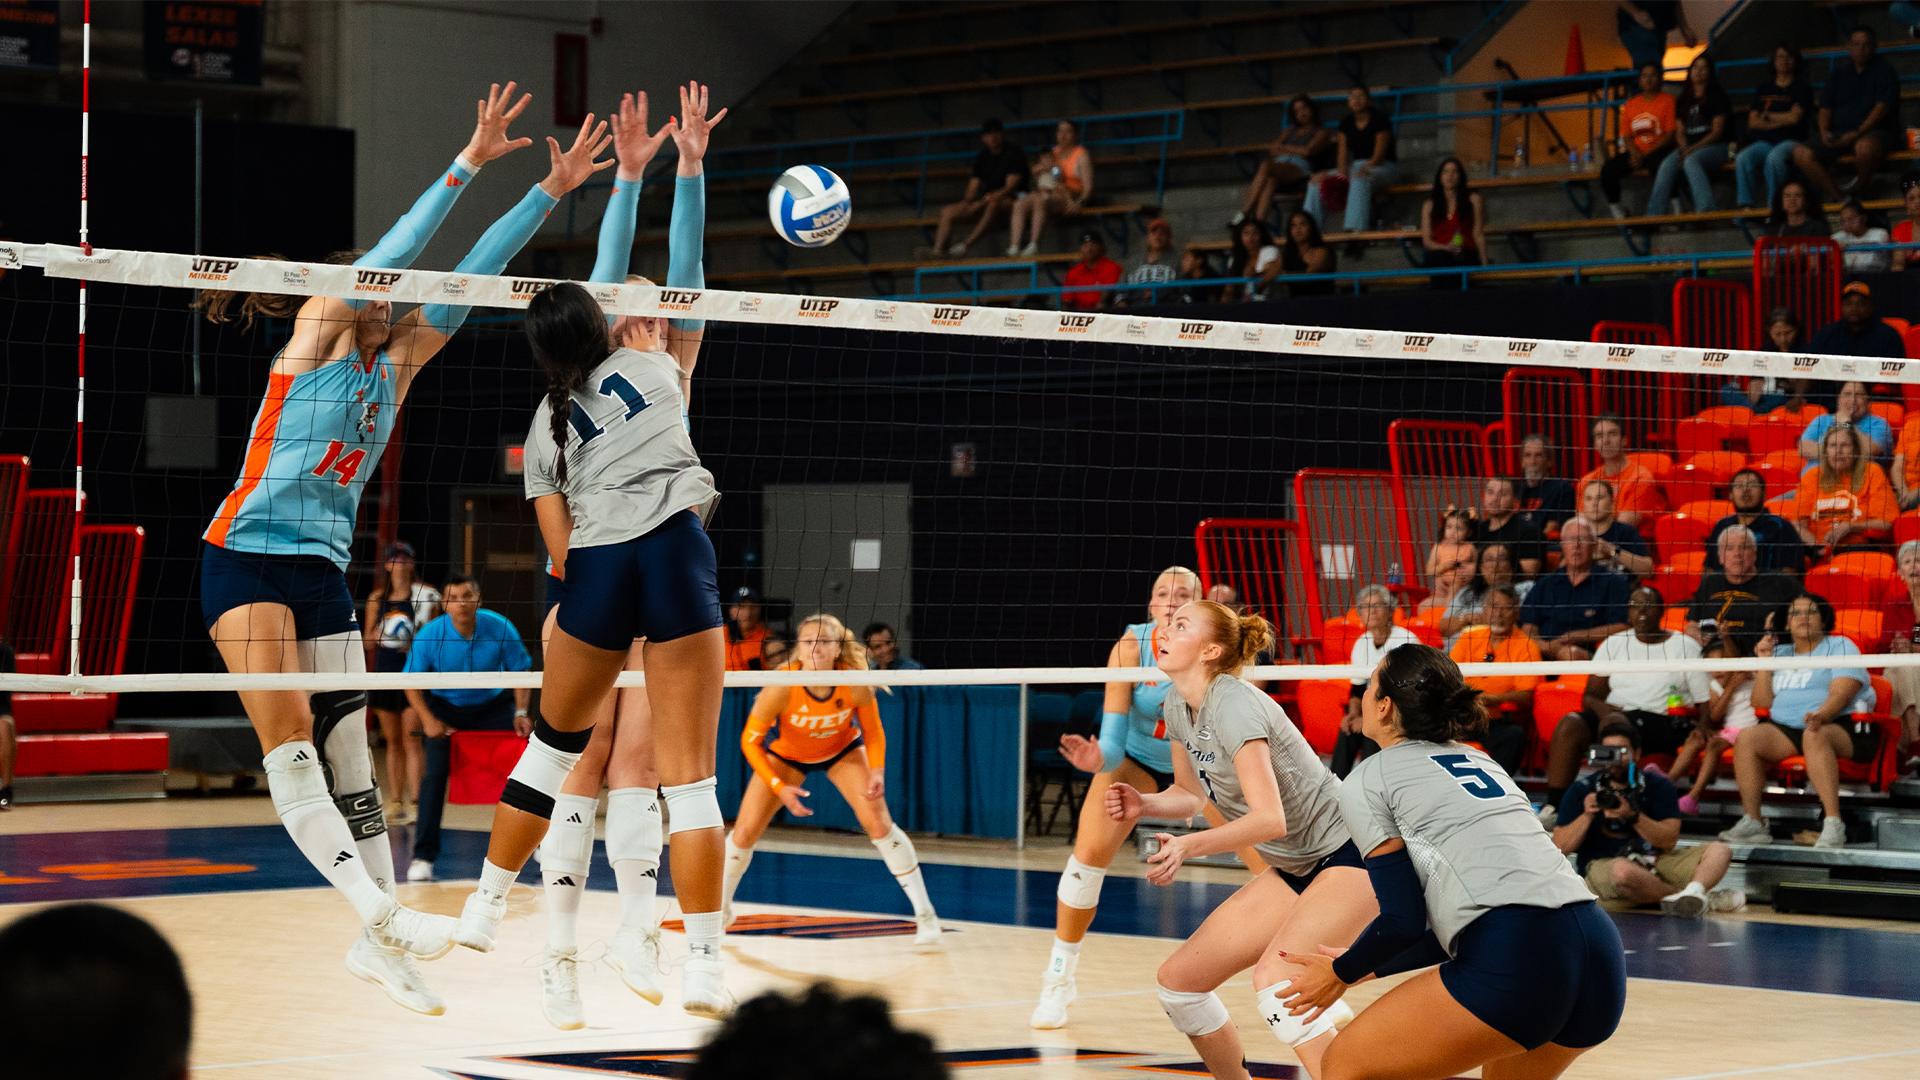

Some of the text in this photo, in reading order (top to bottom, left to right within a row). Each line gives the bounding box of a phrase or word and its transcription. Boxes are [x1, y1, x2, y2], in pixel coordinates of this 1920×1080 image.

[192, 258, 239, 273] UTEP
[189, 272, 228, 281] MINERS
[357, 270, 402, 285] UTEP
[355, 284, 391, 293] MINERS
[660, 290, 702, 304] UTEP
[658, 303, 692, 311] MINERS
[800, 298, 839, 311] UTEP
[933, 307, 971, 320] UTEP
[931, 319, 962, 327] MINERS
[1060, 315, 1095, 327] UTEP
[1181, 322, 1213, 334] UTEP
[1295, 330, 1327, 341] UTEP
[1404, 335, 1434, 347] UTEP
[1508, 341, 1537, 352] UTEP
[1608, 346, 1635, 357] UTEP
[1703, 352, 1729, 362] UTEP
[1794, 357, 1820, 367] UTEP
[1881, 361, 1906, 371] UTEP
[566, 369, 653, 450] 11
[311, 439, 367, 487] 14
[790, 708, 852, 729] UTEP
[1427, 753, 1508, 800] 5
